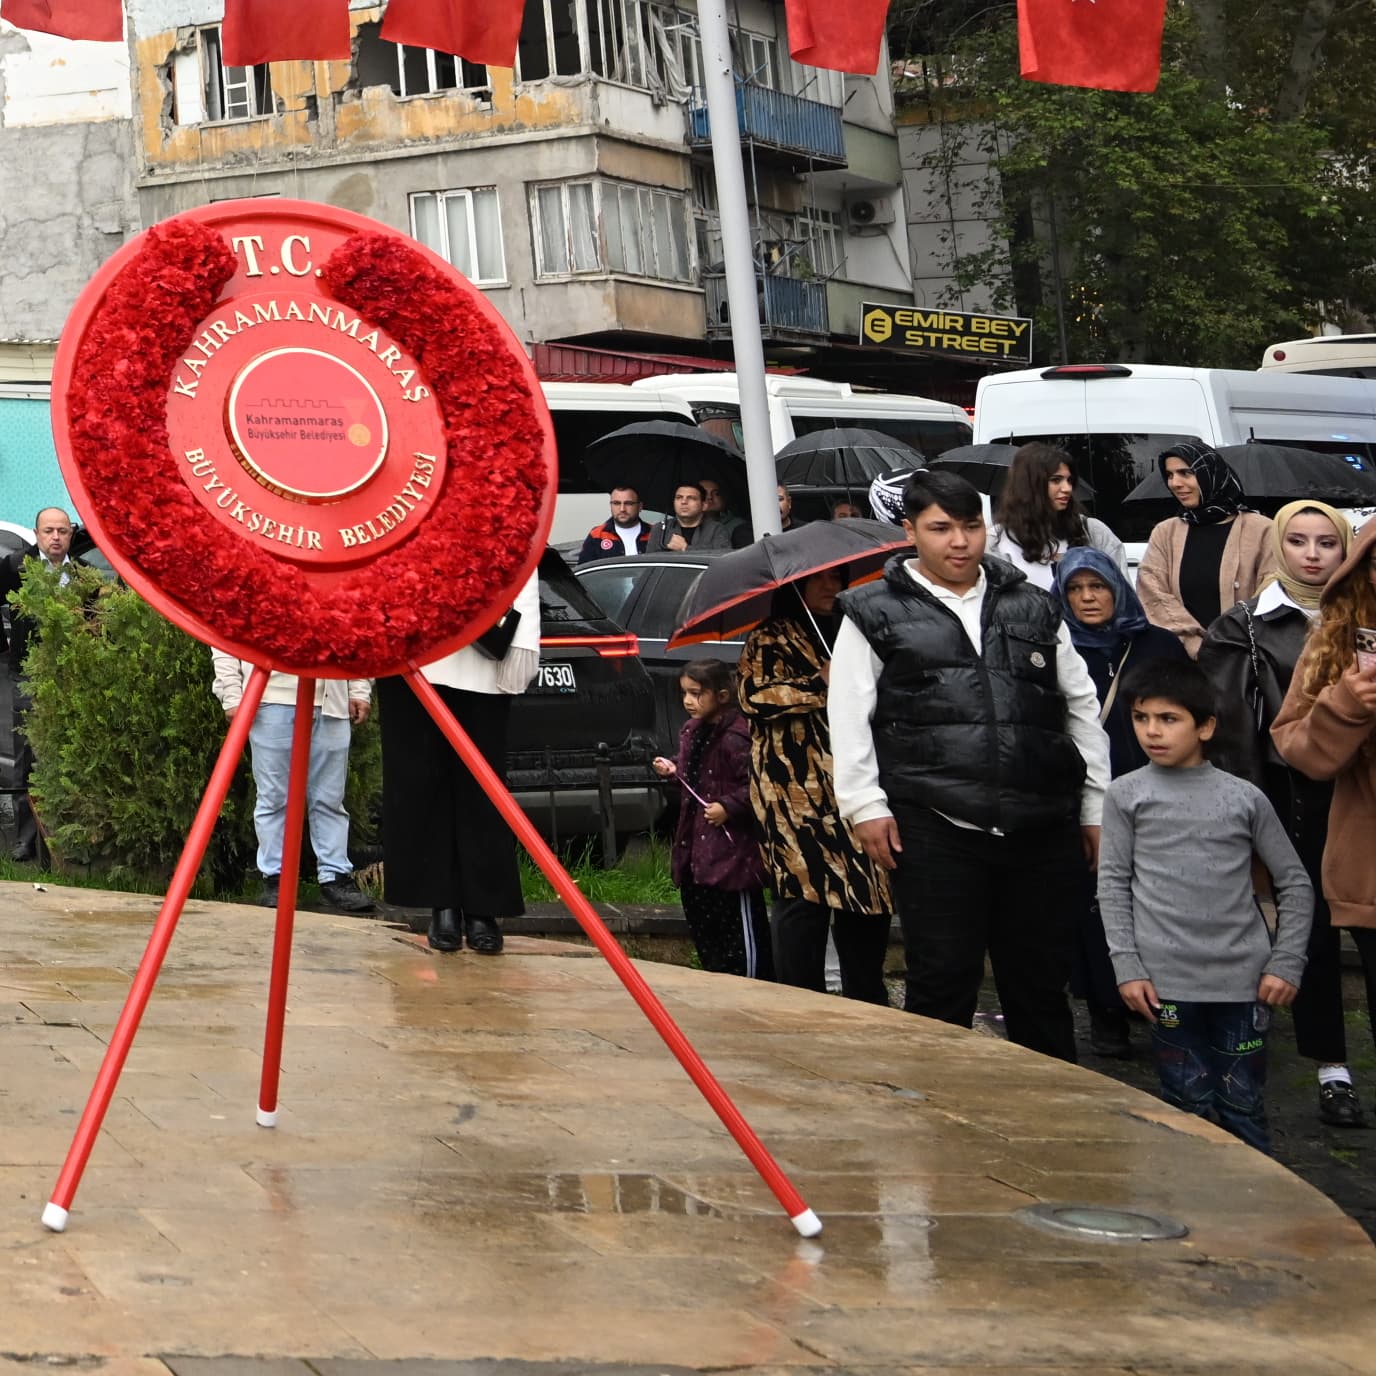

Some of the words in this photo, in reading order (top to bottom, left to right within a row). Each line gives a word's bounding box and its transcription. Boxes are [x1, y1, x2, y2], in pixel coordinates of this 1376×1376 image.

[232, 233, 323, 278] T.C.
[894, 311, 964, 331] EMİR
[970, 318, 1028, 337] BEY
[174, 299, 430, 405] KAHRAMANMARAŞ
[904, 330, 1017, 355] STREET
[183, 446, 323, 551] BÜYÜKŞEHİR
[338, 451, 437, 550] BELEDİYESİ
[1160, 1009, 1178, 1020] 45
[1234, 1038, 1264, 1052] JEANS
